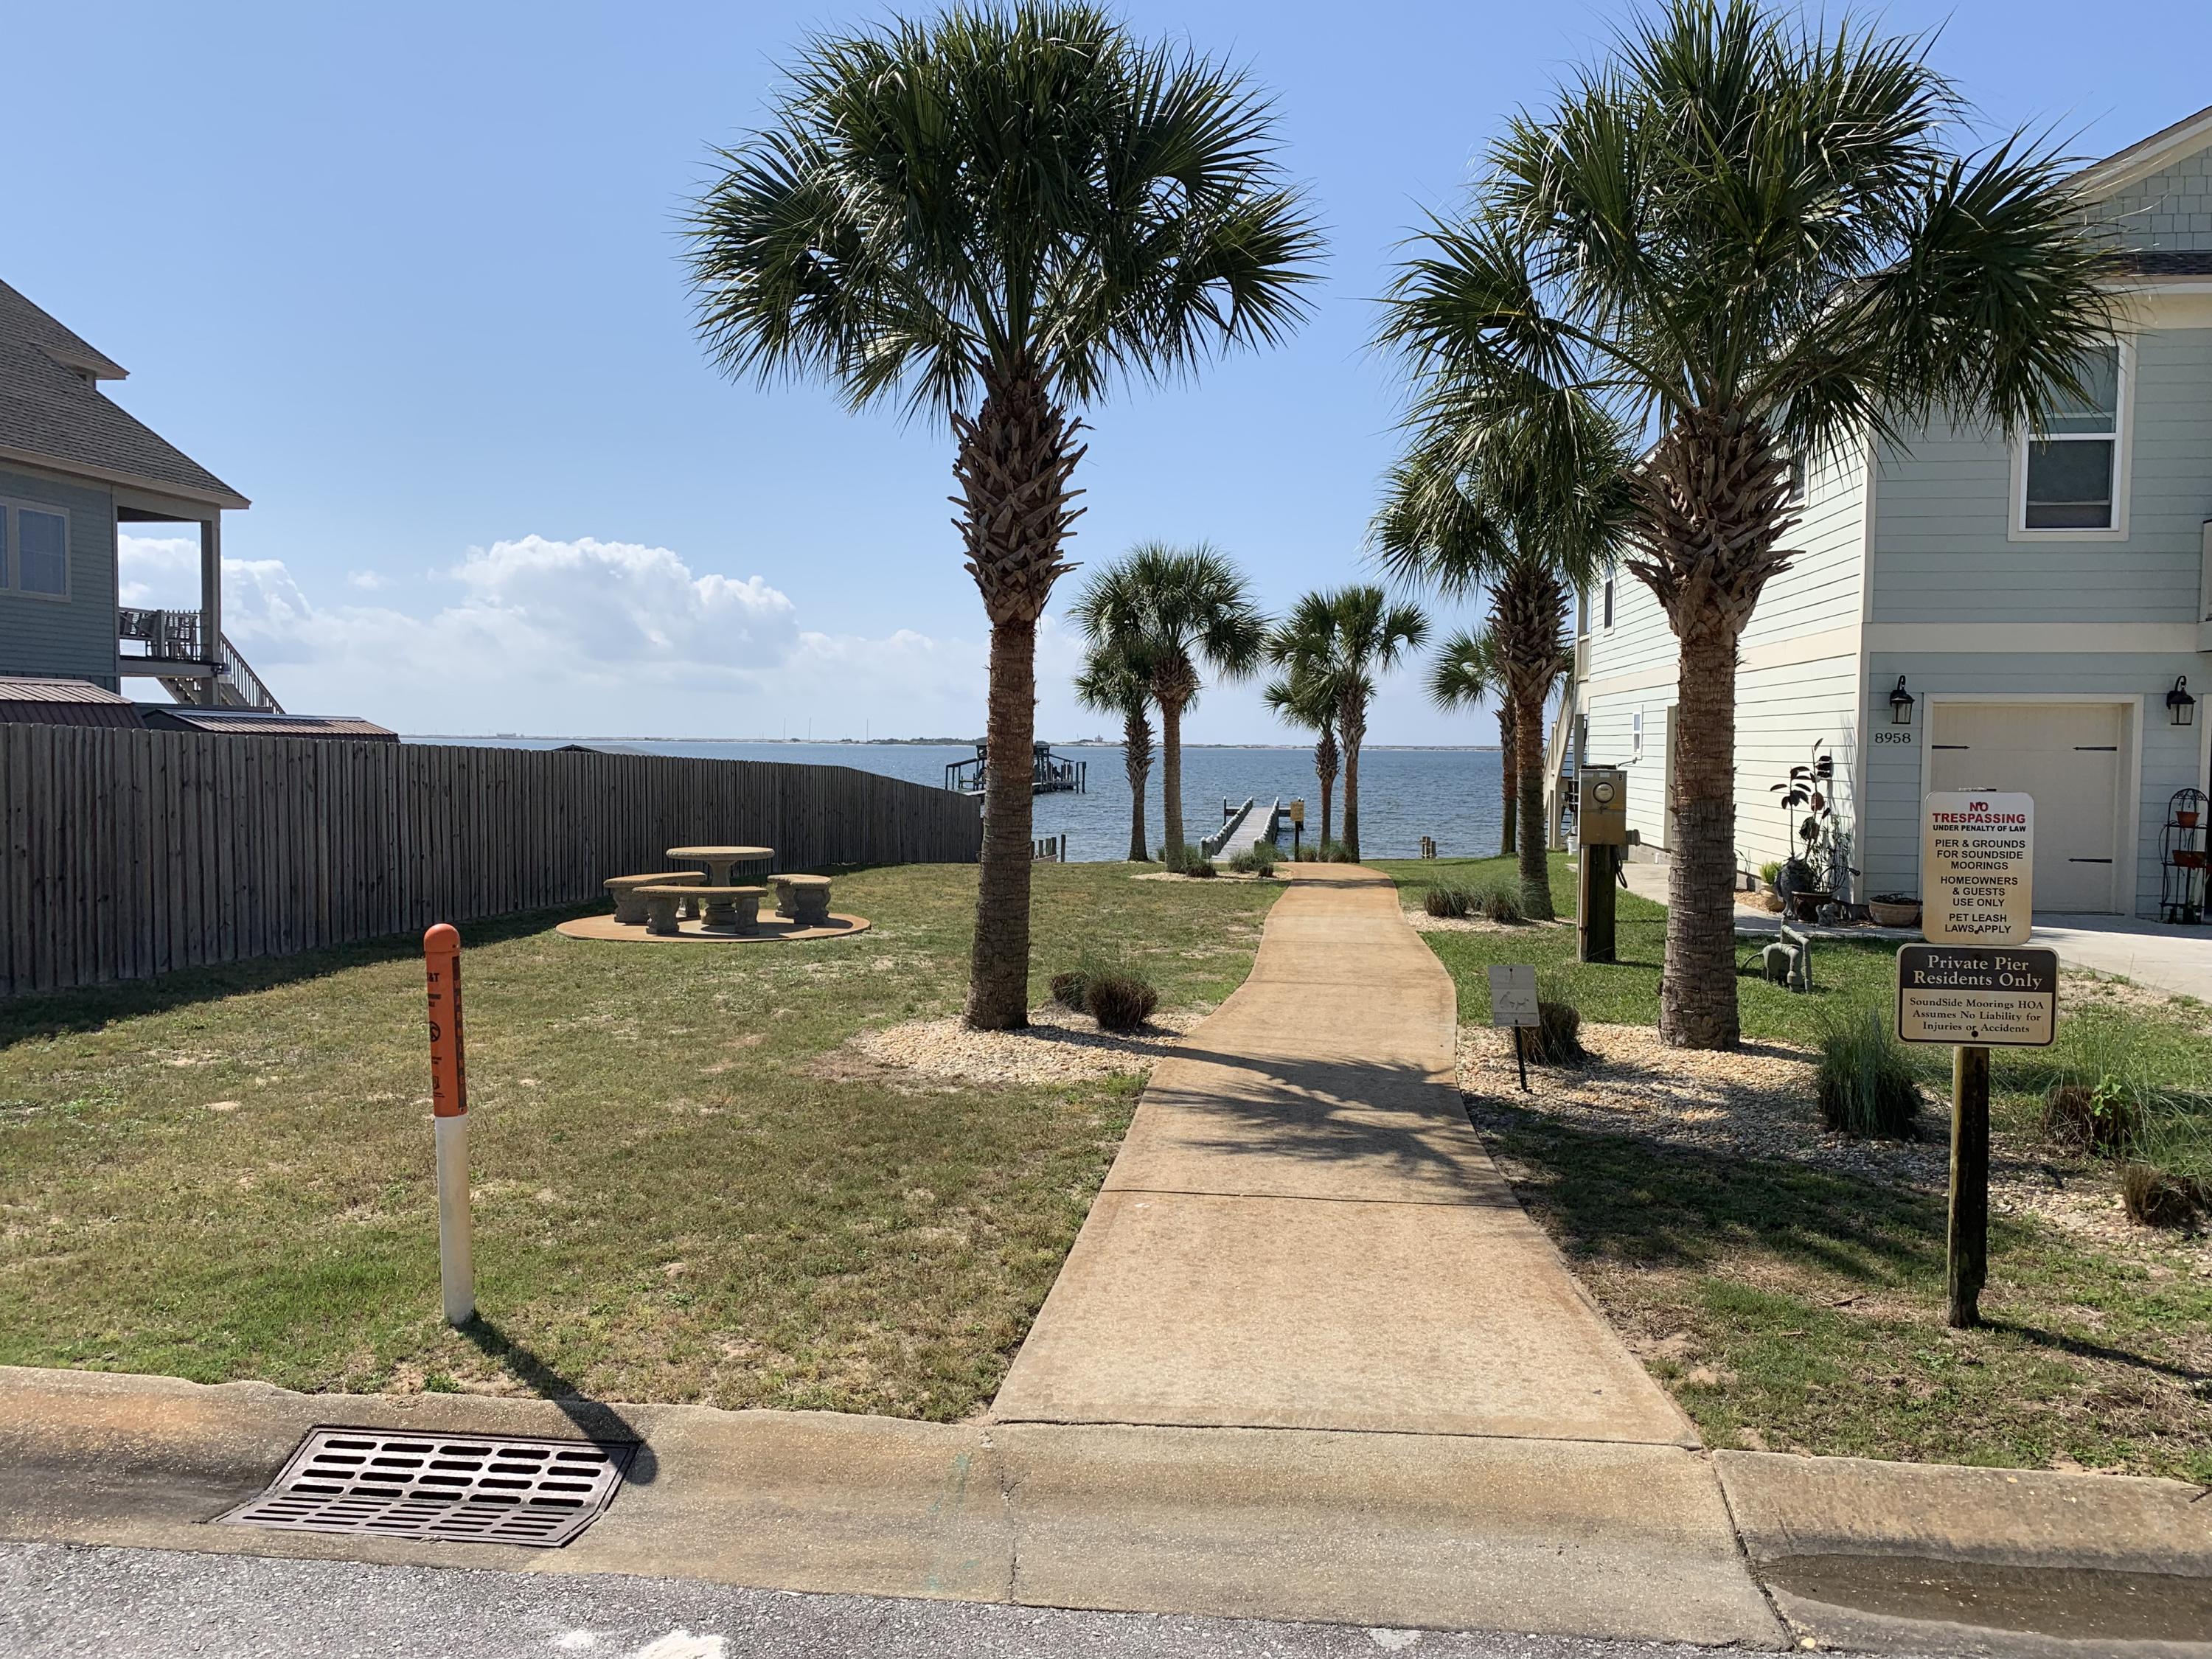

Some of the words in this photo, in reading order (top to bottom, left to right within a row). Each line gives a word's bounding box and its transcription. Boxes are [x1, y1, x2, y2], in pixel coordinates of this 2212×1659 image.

[1875, 732, 1911, 743] 8958
[1969, 801, 1989, 811] NO
[1933, 813, 2025, 823] TRESPASSING
[1935, 839, 1959, 847] PIER
[1972, 840, 2025, 848] GROUNDS
[1961, 851, 2023, 859] SOUNDSIDE
[1951, 861, 2008, 869] MOORINGS
[1941, 876, 2018, 885] HOMEOWNERS
[1963, 888, 2006, 896] GUESTS
[1953, 898, 1973, 906] USE
[1977, 899, 2005, 907] ONLY
[1950, 914, 1969, 922] PET
[1972, 914, 2007, 922] LEASH
[1978, 925, 2011, 933] APPLY
[1927, 955, 1989, 970] Private
[1995, 956, 2029, 971] Pier
[1913, 970, 1992, 986] Residents
[1999, 973, 2042, 990] Only
[1910, 998, 1963, 1006] SoundSide
[1966, 999, 2014, 1009] Moorings
[2018, 1001, 2044, 1009] HOA
[1913, 1010, 1956, 1018] Assumes
[1961, 1011, 1975, 1019] No
[1980, 1012, 2022, 1022] Liability
[2026, 1013, 2041, 1021] for
[1923, 1022, 1962, 1032] Injuries
[1980, 1024, 2030, 1032] Accidents
